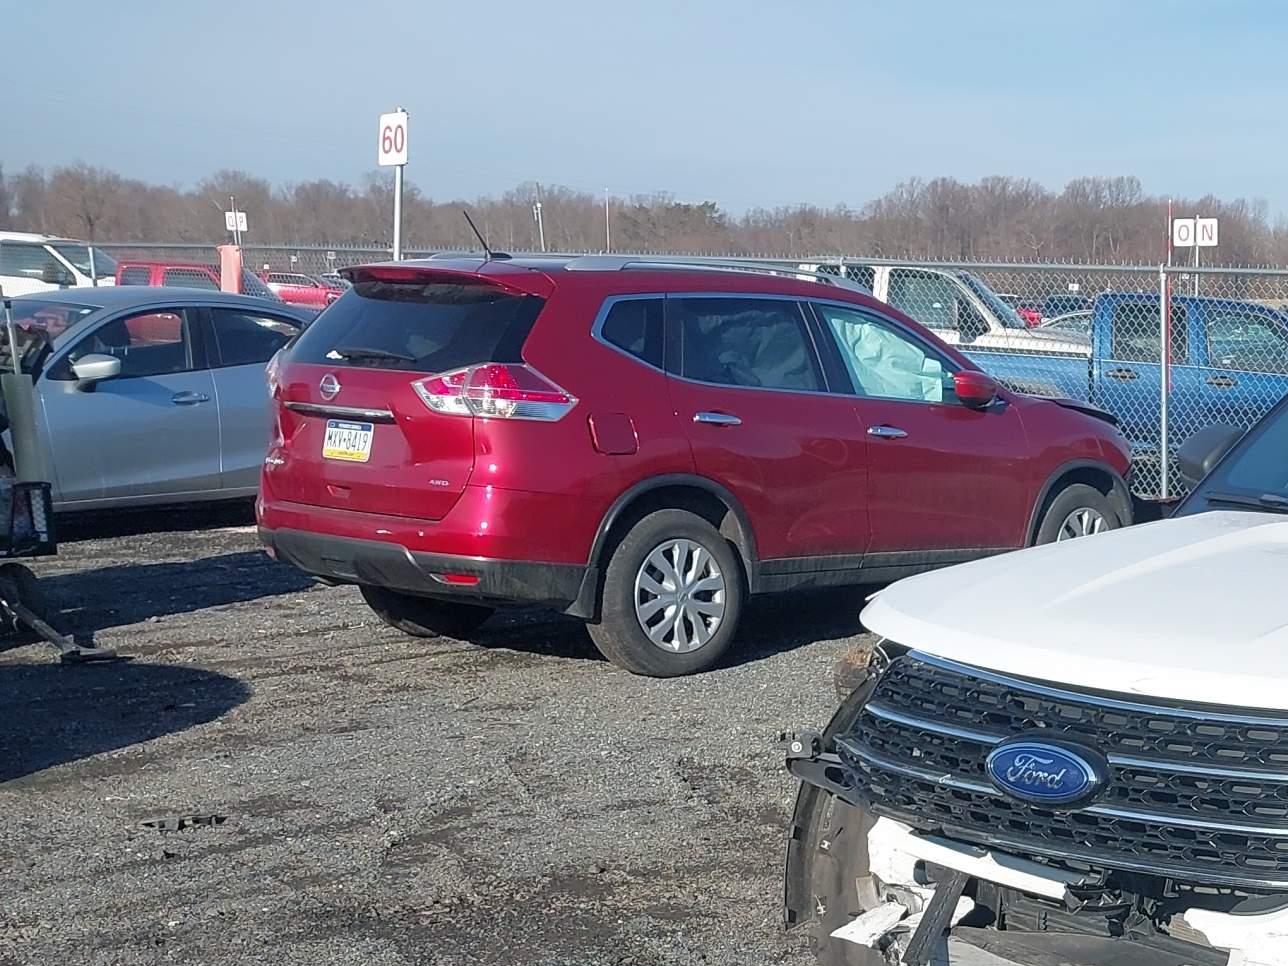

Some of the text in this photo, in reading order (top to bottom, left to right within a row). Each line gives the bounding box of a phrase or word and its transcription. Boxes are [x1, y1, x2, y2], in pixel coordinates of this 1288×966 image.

[382, 124, 405, 154] 60
[1201, 223, 1213, 241] N
[1007, 753, 1067, 789] Ford
